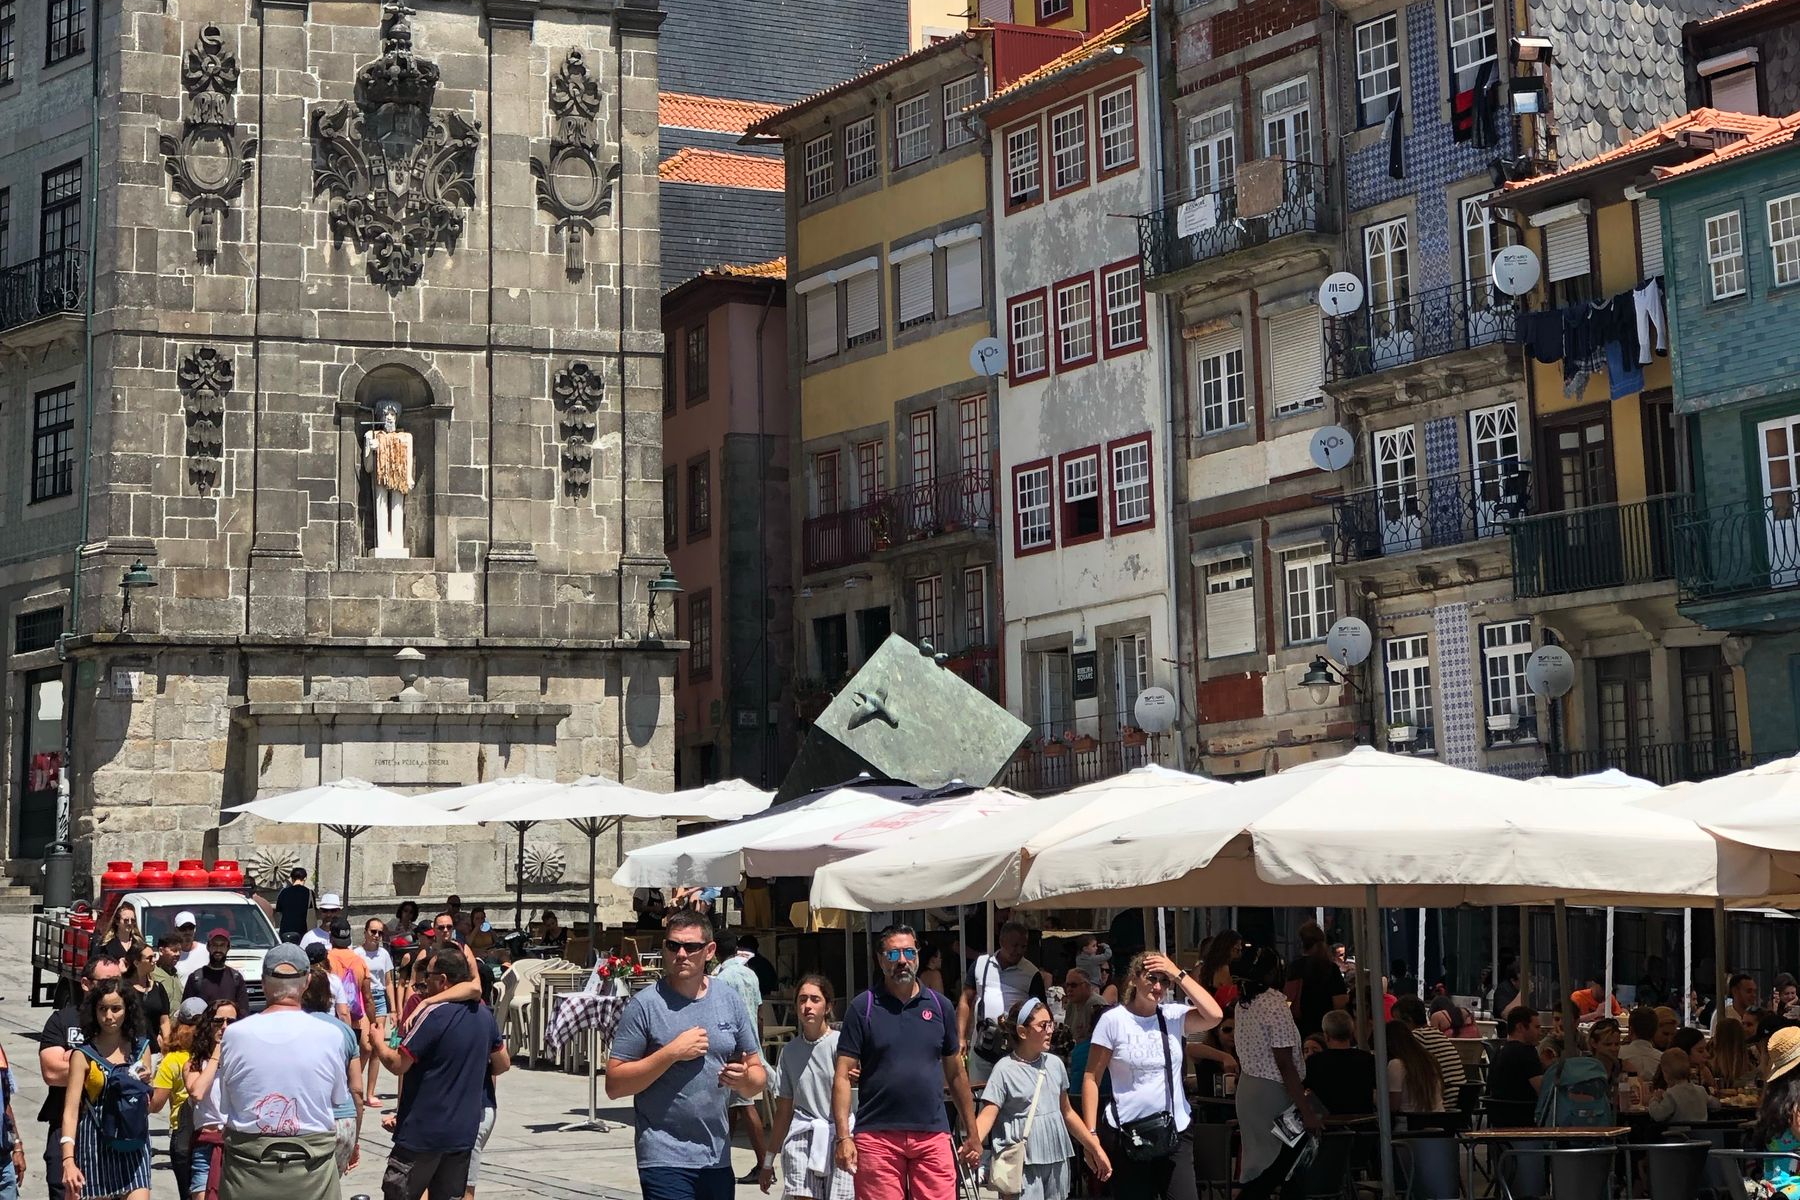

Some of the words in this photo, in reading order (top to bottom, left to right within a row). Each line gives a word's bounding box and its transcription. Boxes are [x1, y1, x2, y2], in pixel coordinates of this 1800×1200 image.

[1328, 282, 1356, 292] MEO
[1319, 436, 1344, 448] NOS
[1076, 673, 1094, 681] SQUARE
